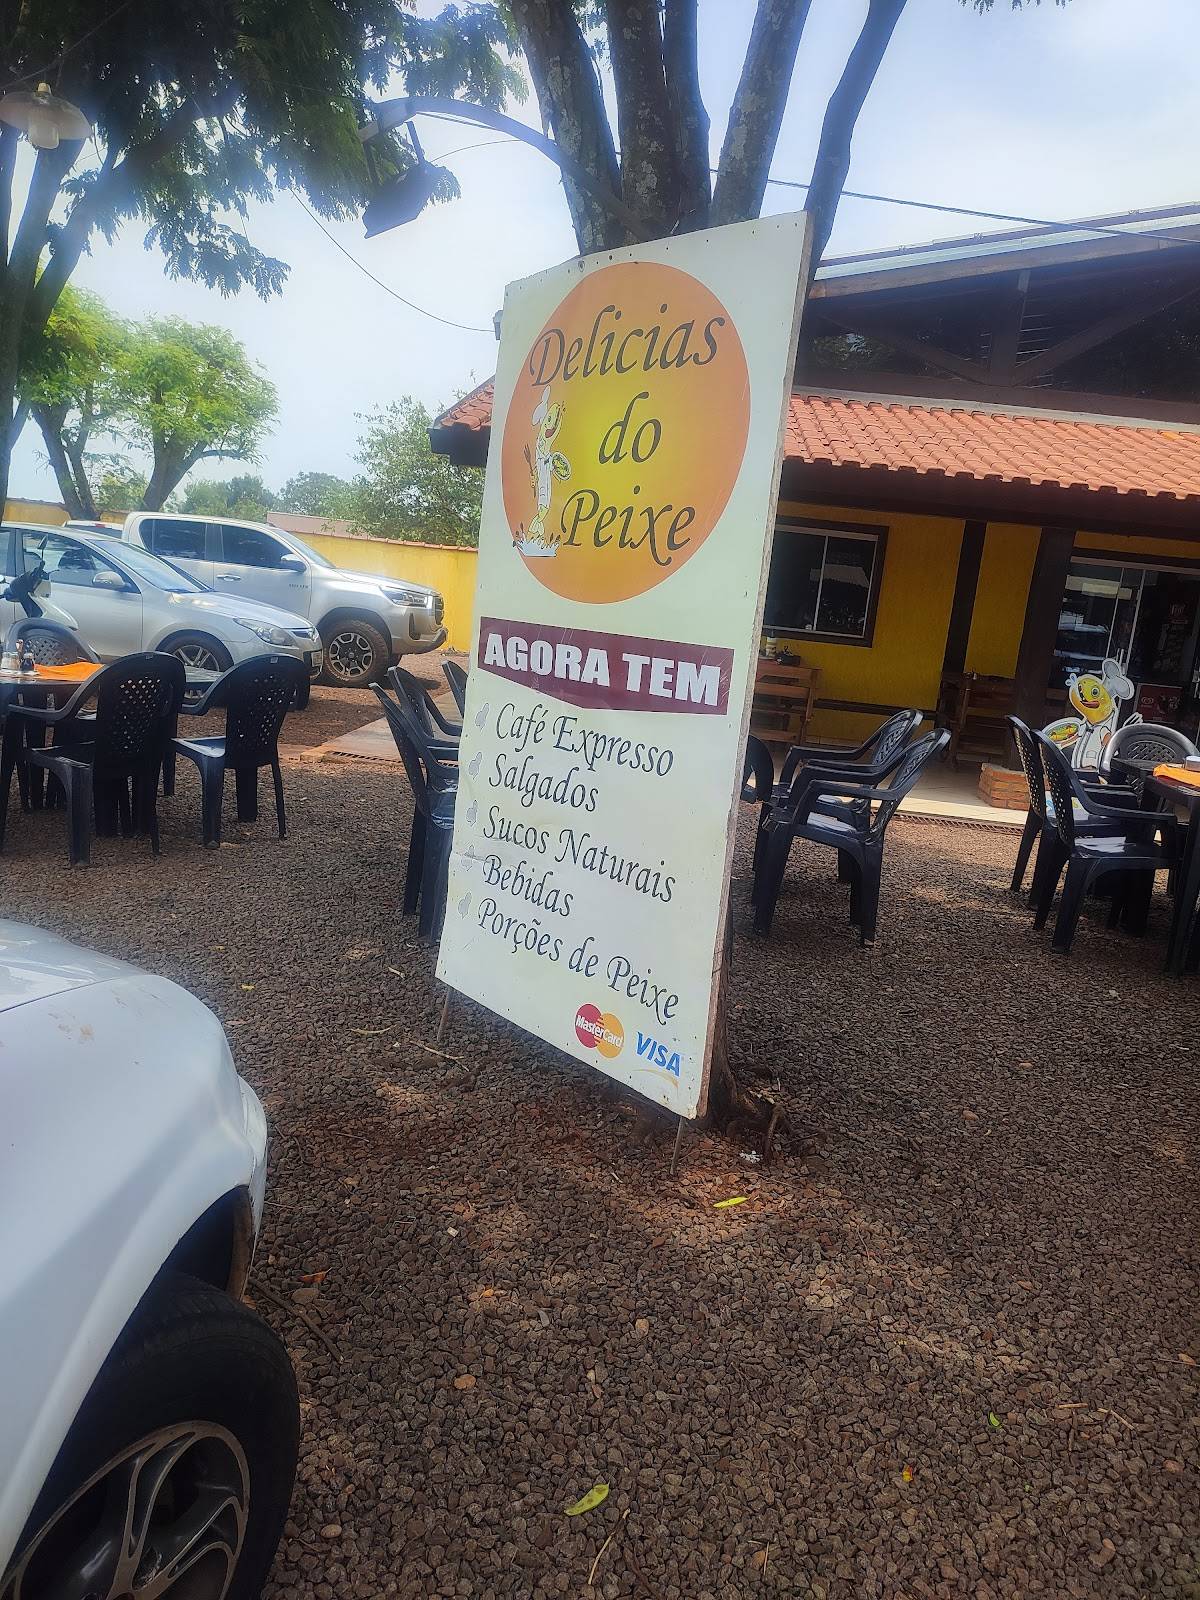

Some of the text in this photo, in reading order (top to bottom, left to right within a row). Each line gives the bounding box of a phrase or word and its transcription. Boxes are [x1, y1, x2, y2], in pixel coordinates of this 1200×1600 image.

[529, 303, 726, 387] Delicias
[598, 391, 662, 465] do
[561, 485, 696, 566] Peixe
[484, 632, 721, 707] AGORA TEM
[496, 702, 674, 777] Café Expresso
[488, 753, 599, 812] Salgados
[482, 854, 574, 917] Bebidas
[483, 805, 676, 903] Sucos Naturais
[478, 898, 679, 1026] Porções de Peixe
[575, 1014, 624, 1048] MasterCard
[636, 1031, 681, 1077] VISA
